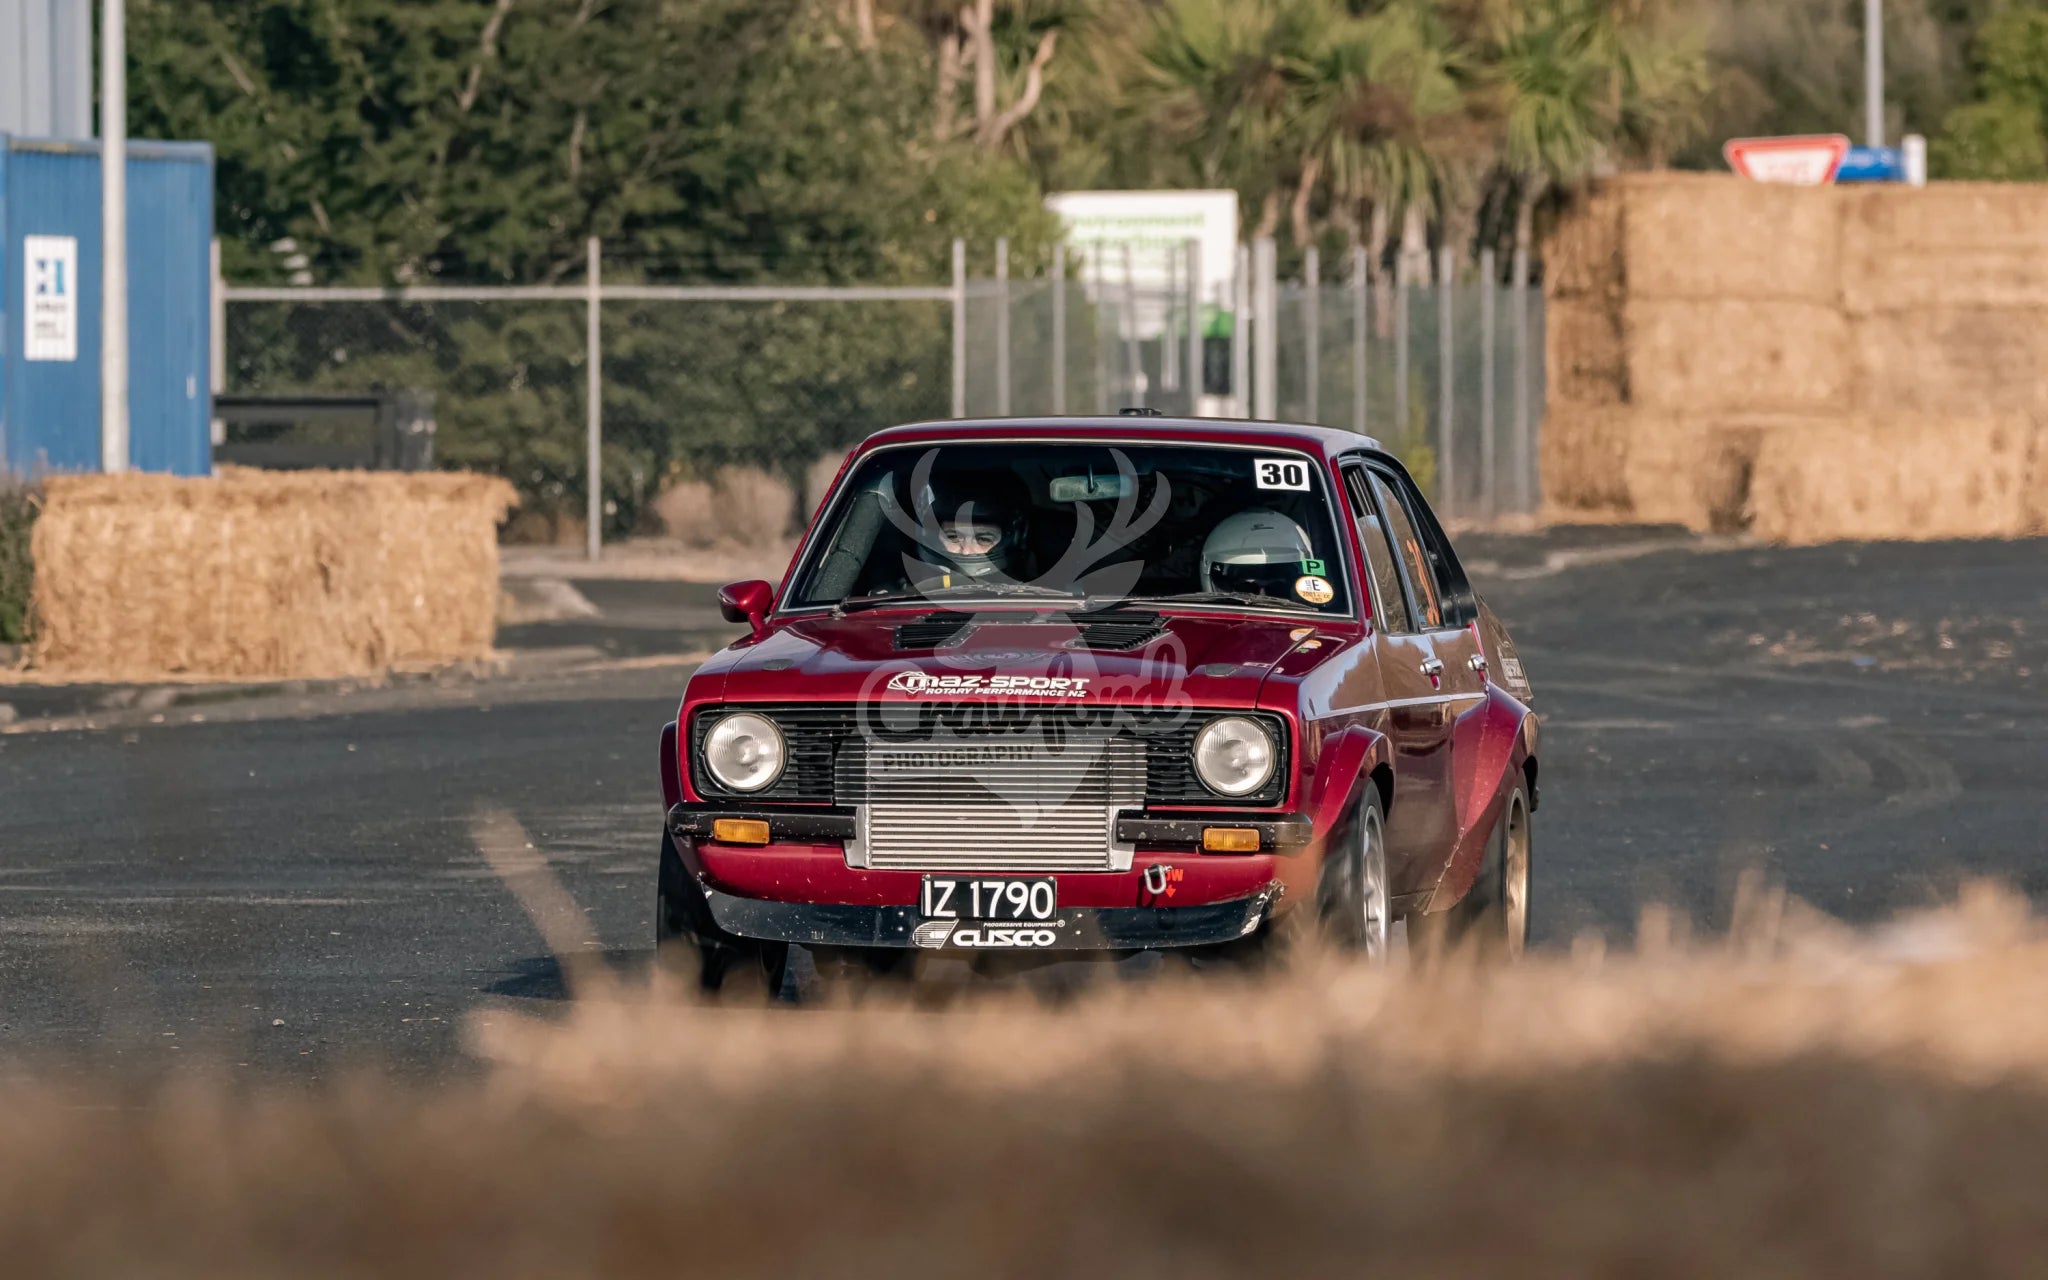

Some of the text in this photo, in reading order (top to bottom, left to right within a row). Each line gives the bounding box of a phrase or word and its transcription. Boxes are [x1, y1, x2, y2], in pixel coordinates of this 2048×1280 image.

[1261, 463, 1304, 487] 30
[1306, 560, 1321, 574] P
[1311, 579, 1321, 592] E
[925, 687, 1087, 698] ROTARY PERFORMANCE NZ
[925, 880, 1054, 920] IZ 1790
[952, 929, 1057, 947] CUSCO
